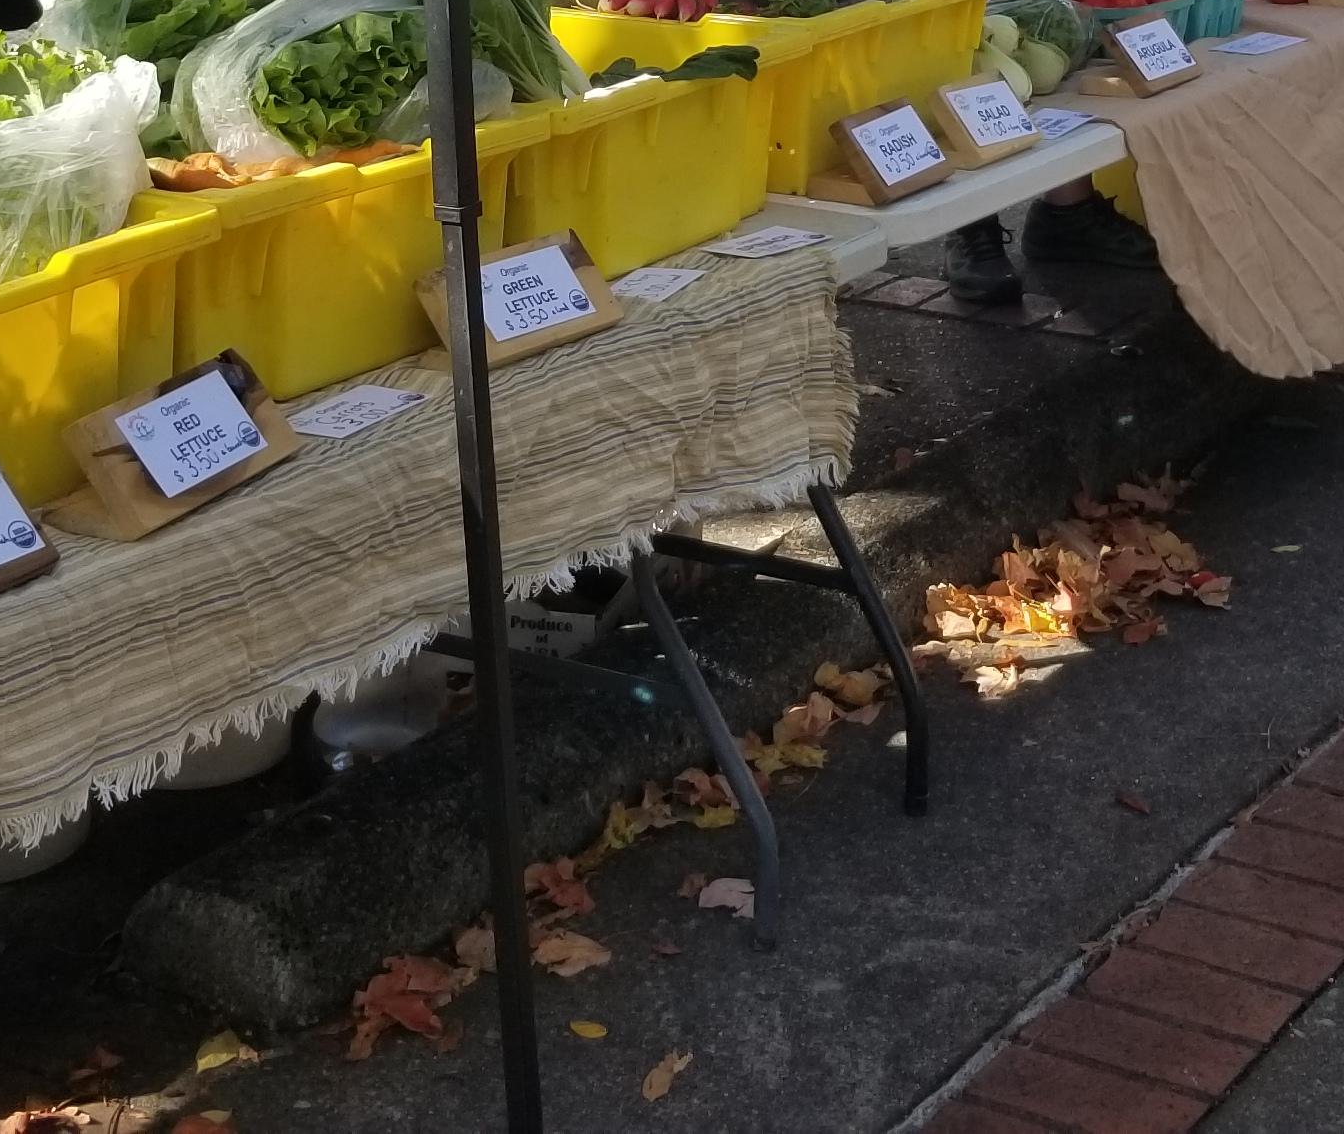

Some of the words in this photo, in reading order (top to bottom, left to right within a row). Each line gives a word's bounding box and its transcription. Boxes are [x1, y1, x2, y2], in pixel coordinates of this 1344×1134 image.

[1136, 38, 1176, 60] ARUGULA
[977, 104, 1011, 123] SALAD
[879, 132, 918, 157] RADISH
[502, 274, 544, 295] GREEN
[504, 288, 560, 314] LETTUCE
[160, 397, 191, 417] Organic
[173, 413, 201, 435] RED
[170, 424, 227, 462] LETTUCE
